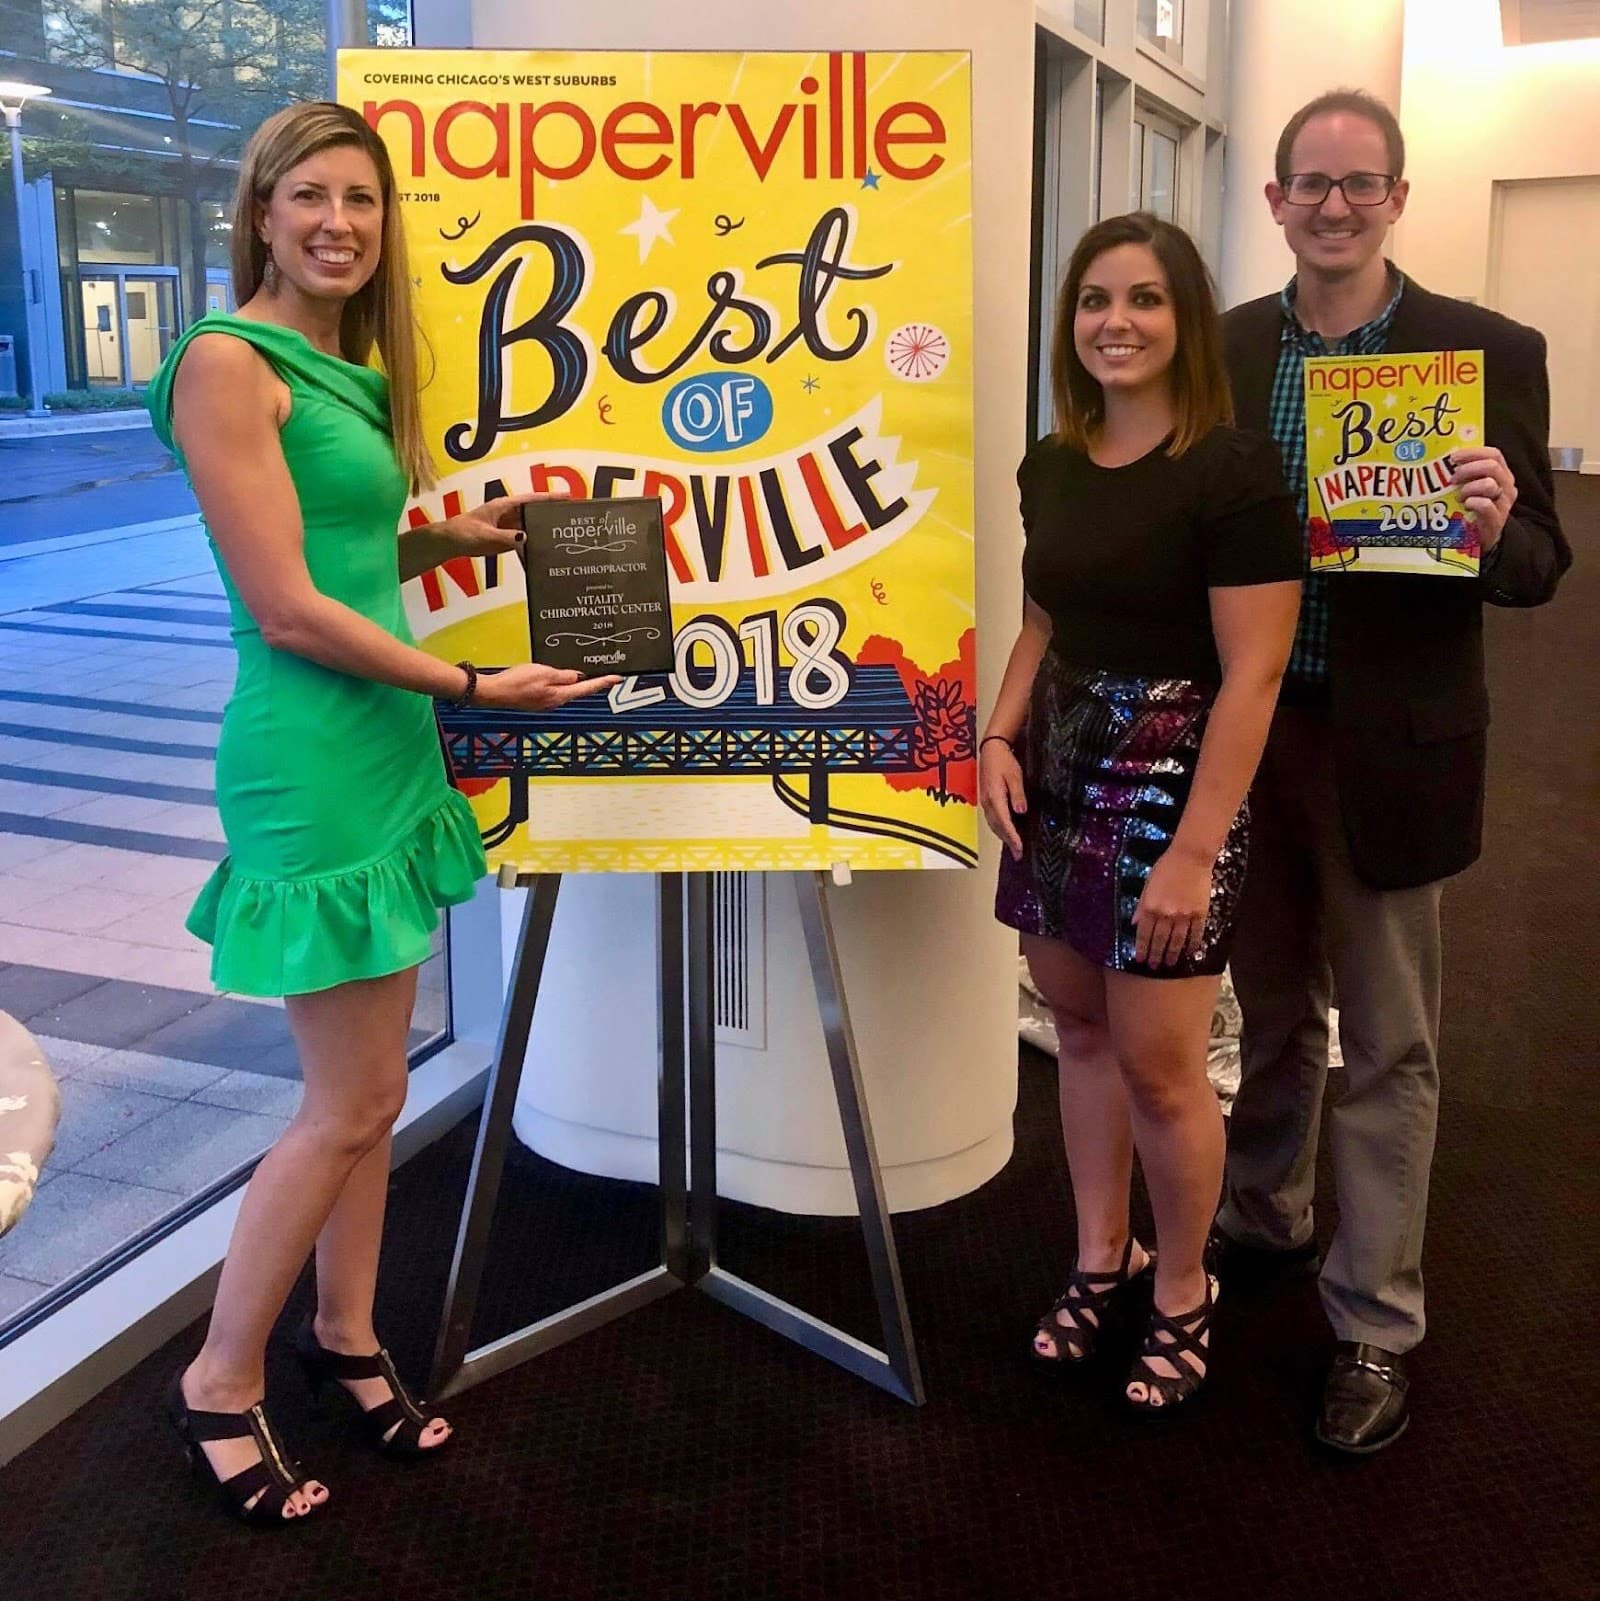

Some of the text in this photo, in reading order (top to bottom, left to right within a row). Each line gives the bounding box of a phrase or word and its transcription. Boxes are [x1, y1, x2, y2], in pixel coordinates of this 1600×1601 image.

[363, 73, 617, 86] COVERING CHICAGO'S WEST SUBURBS
[363, 52, 947, 220] naperville
[414, 193, 440, 202] 2018
[440, 206, 894, 463] Best
[1309, 350, 1478, 400] naperville
[672, 377, 757, 444] OF
[1331, 392, 1462, 465] Best
[570, 517, 596, 526] BEST
[1379, 501, 1449, 532] 2018
[552, 517, 637, 543] naperville
[549, 562, 647, 577] BEST CHIROPRACTOR
[540, 602, 662, 619] CHIROPRACTIC CENTER
[576, 593, 624, 605] VITALITY
